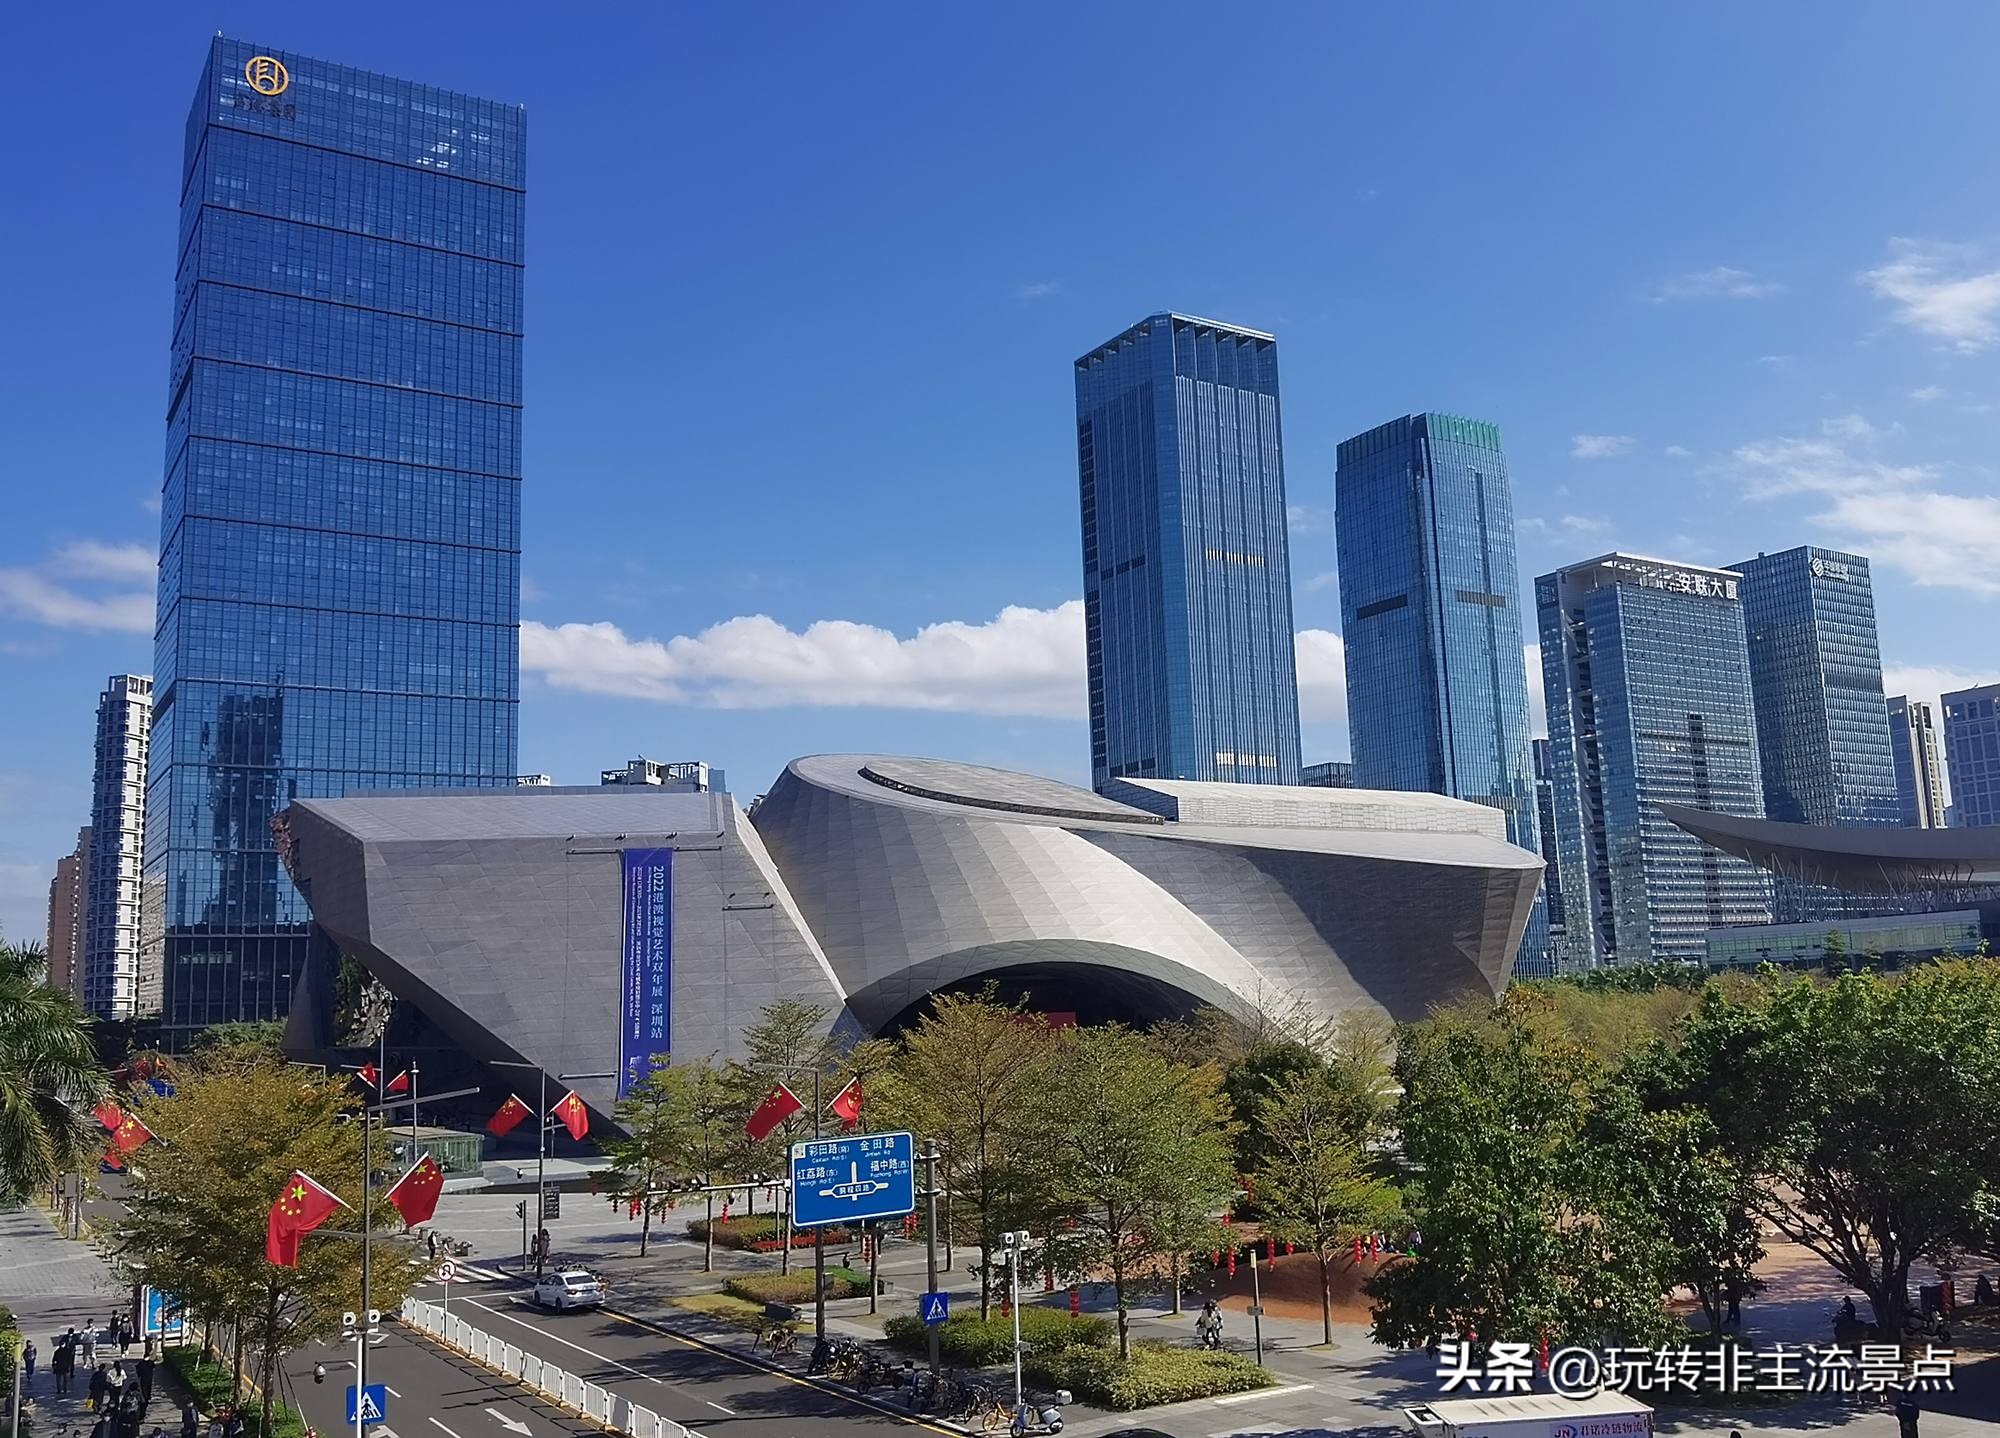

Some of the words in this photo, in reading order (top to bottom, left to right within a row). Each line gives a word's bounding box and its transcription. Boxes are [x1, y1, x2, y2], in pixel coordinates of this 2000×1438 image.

[1679, 573, 1739, 600] 安联大厦
[650, 1003, 664, 1039] 深圳站
[860, 1137, 895, 1152] 金田路
